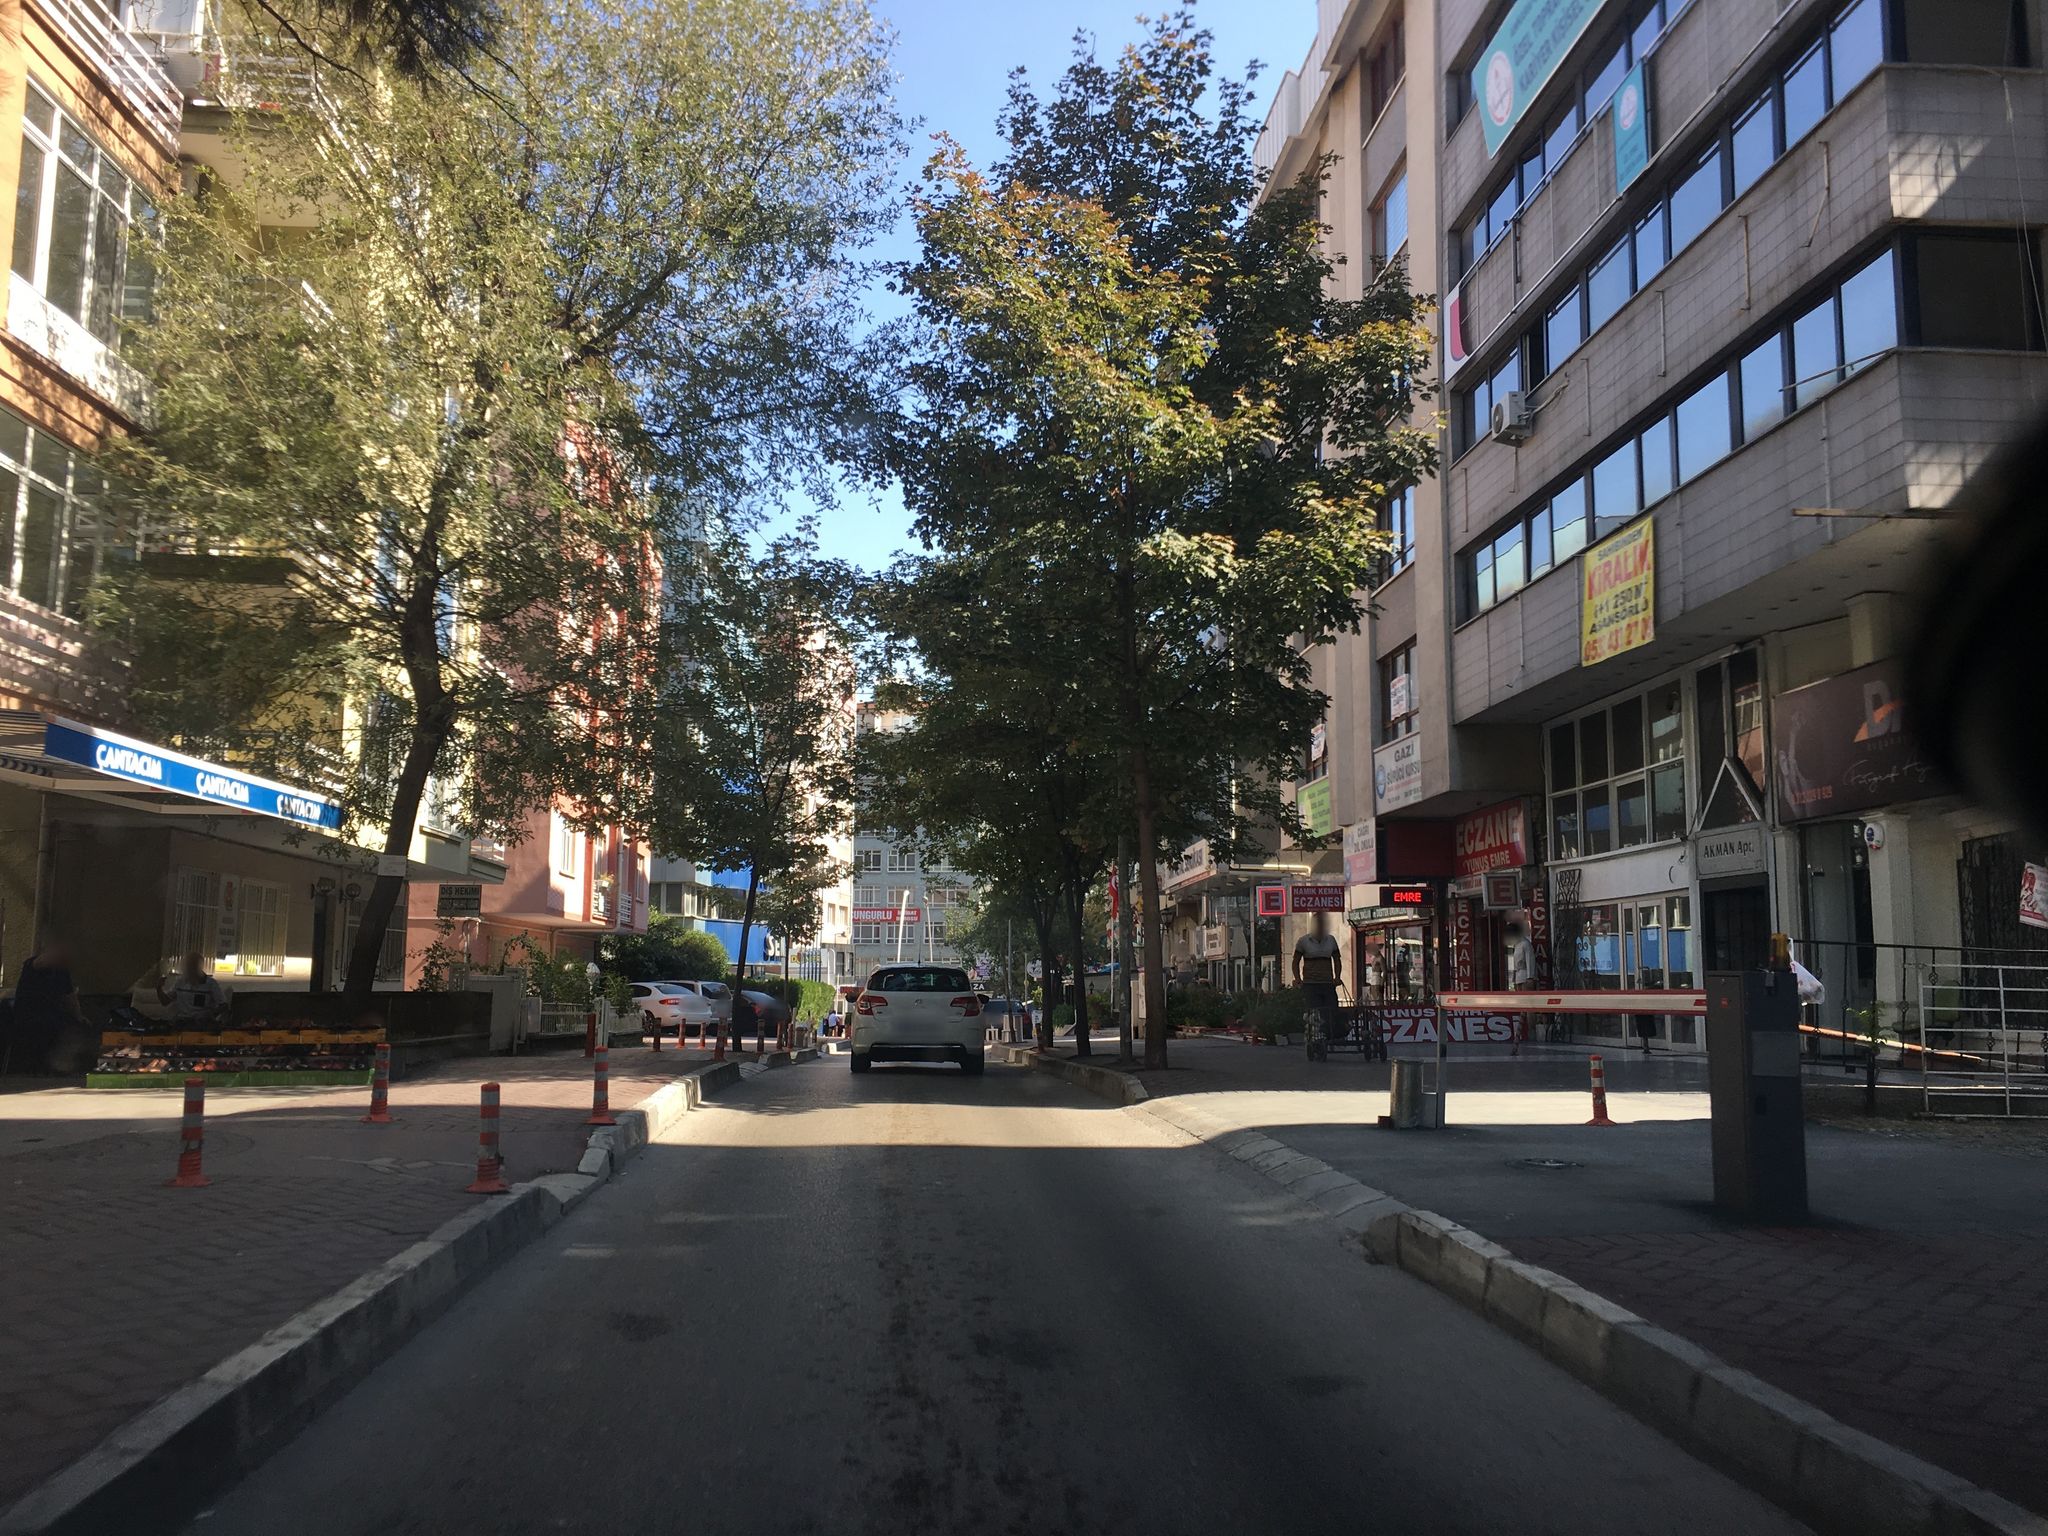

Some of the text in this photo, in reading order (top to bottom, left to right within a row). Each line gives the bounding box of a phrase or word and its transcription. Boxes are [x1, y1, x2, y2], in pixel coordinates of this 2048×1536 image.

[96, 744, 162, 780] ÇANTACIM
[1394, 744, 1414, 762] GAZİ
[196, 772, 250, 804] ÇANTACIM
[1456, 807, 1520, 856] ECZANE
[1703, 841, 1735, 859] AKMAN
[1465, 850, 1511, 872] YUNUS EMRE
[1293, 887, 1343, 895] NAMIK KEMAL
[1393, 892, 1422, 902] EMRE
[1293, 895, 1343, 908] ECZANESİ
[853, 910, 892, 920] UNGURLU
